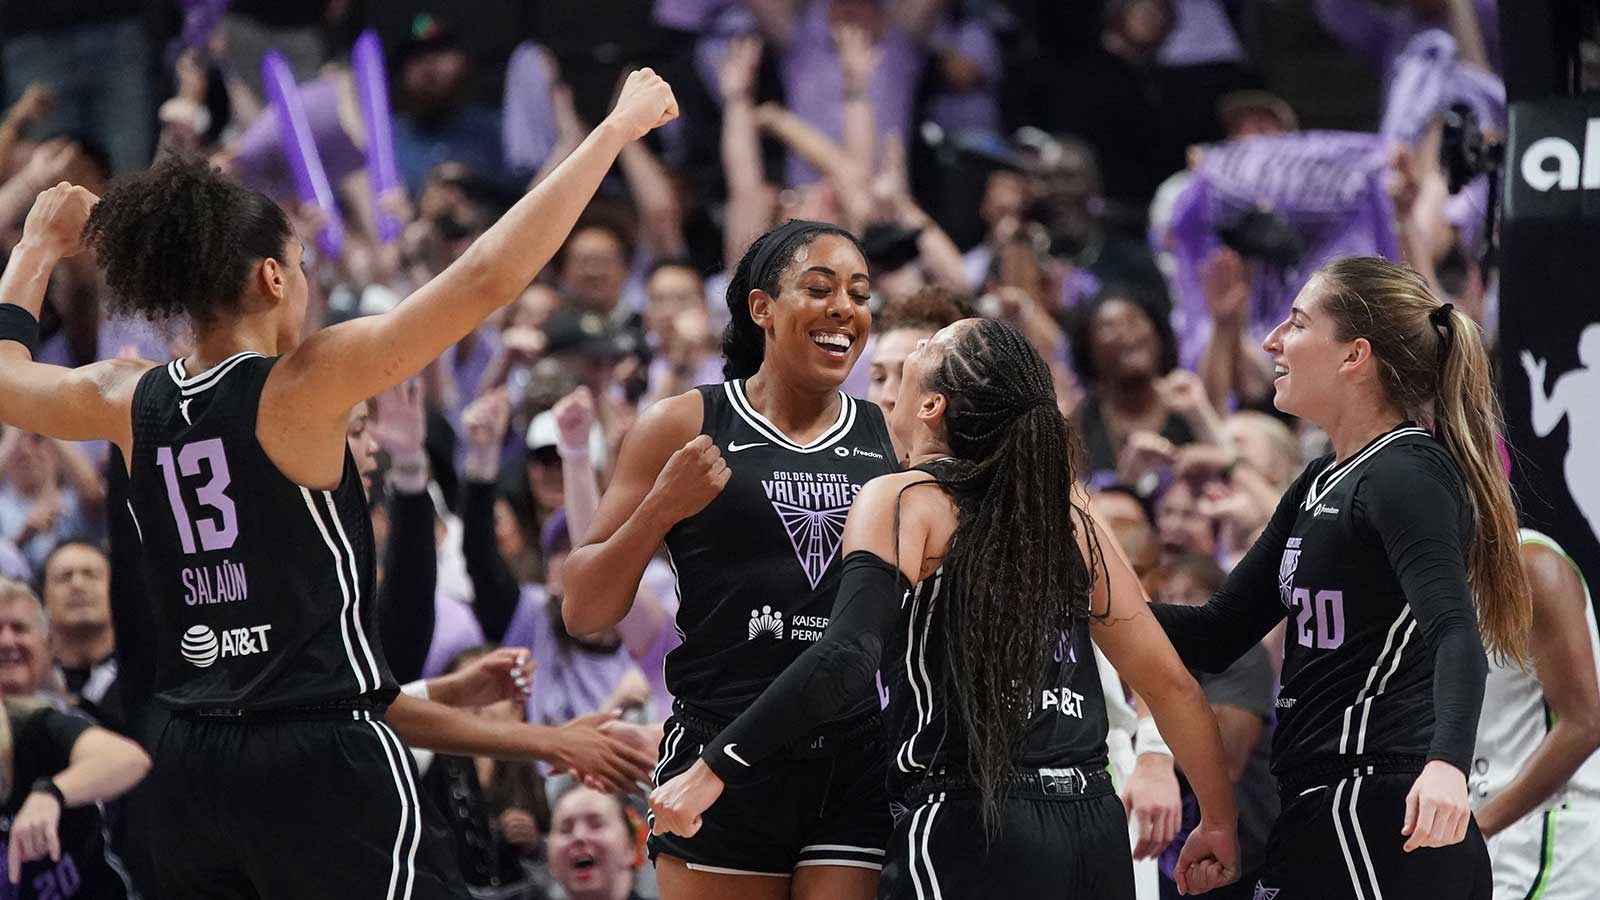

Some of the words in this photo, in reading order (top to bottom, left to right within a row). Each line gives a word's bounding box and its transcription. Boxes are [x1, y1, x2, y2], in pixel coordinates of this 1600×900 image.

[853, 447, 884, 460] freedom
[773, 471, 813, 482] GOLDEN
[816, 473, 849, 483] STATE
[156, 437, 239, 554] 13
[792, 615, 829, 628] KAISER
[1292, 587, 1345, 650] 20
[221, 624, 272, 658] AT&T
